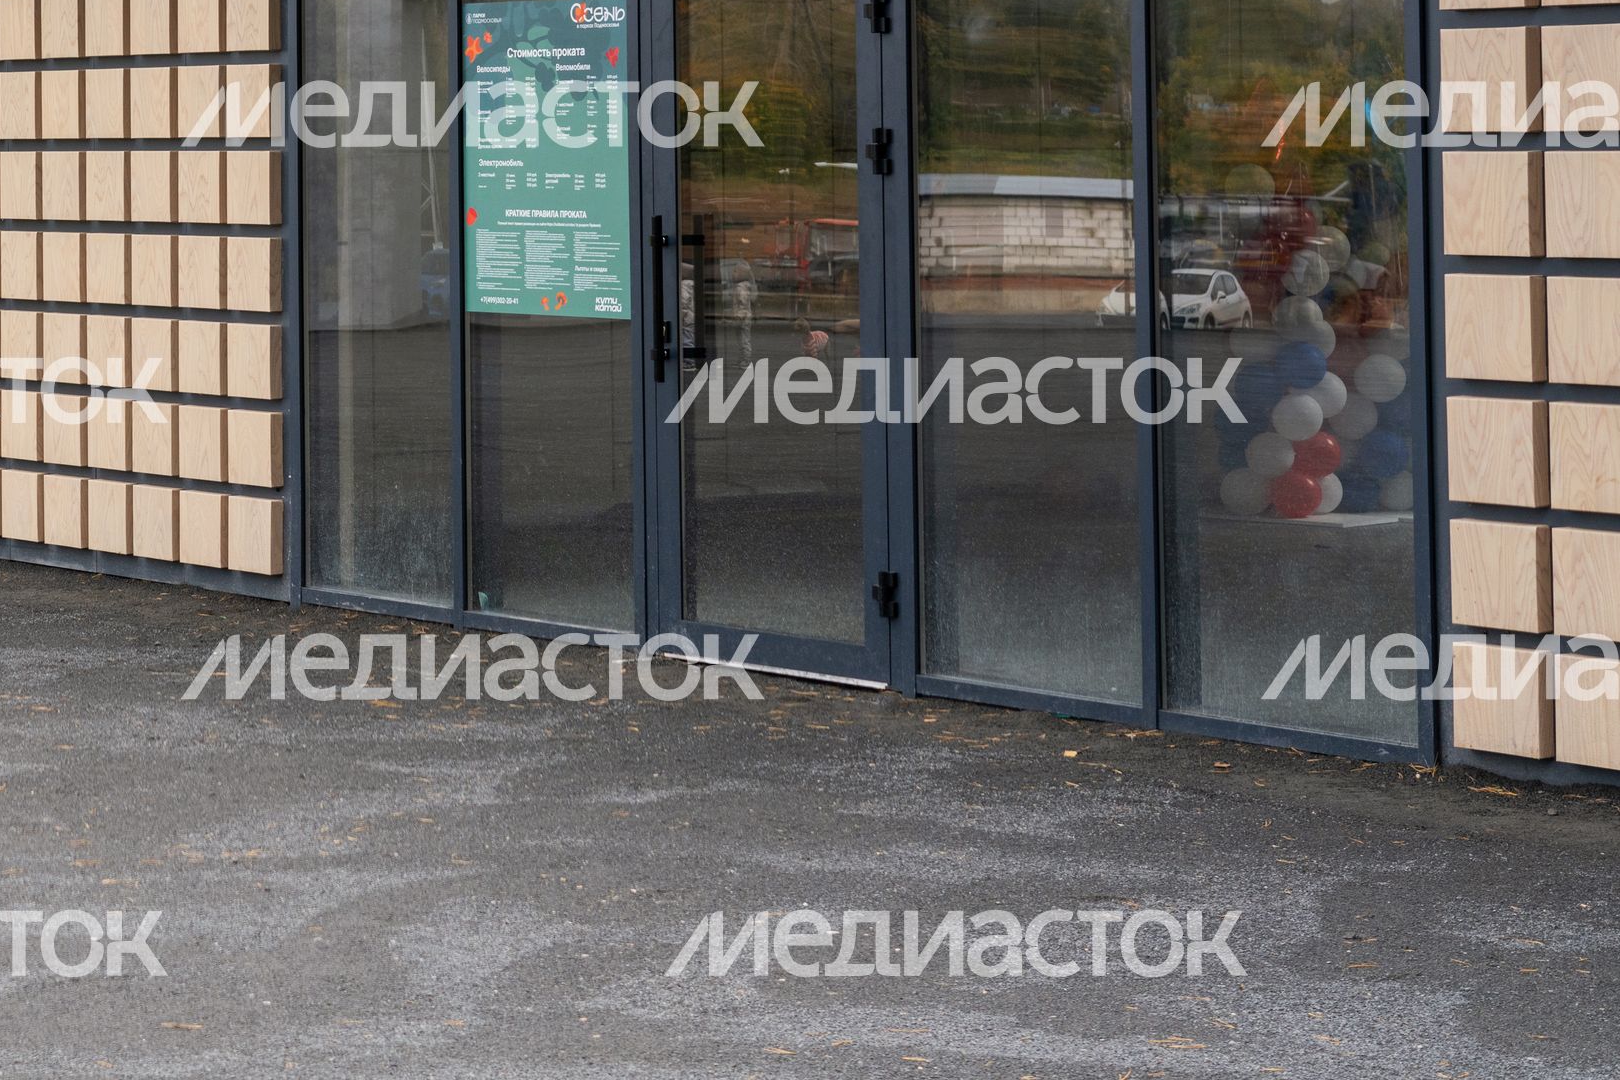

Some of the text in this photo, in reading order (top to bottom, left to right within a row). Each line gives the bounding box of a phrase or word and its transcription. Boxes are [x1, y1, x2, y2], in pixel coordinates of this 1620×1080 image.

[506, 47, 586, 60] Стоимость проката
[531, 210, 559, 218] ПРАВИЛА
[560, 210, 587, 219] ПРОКАТА
